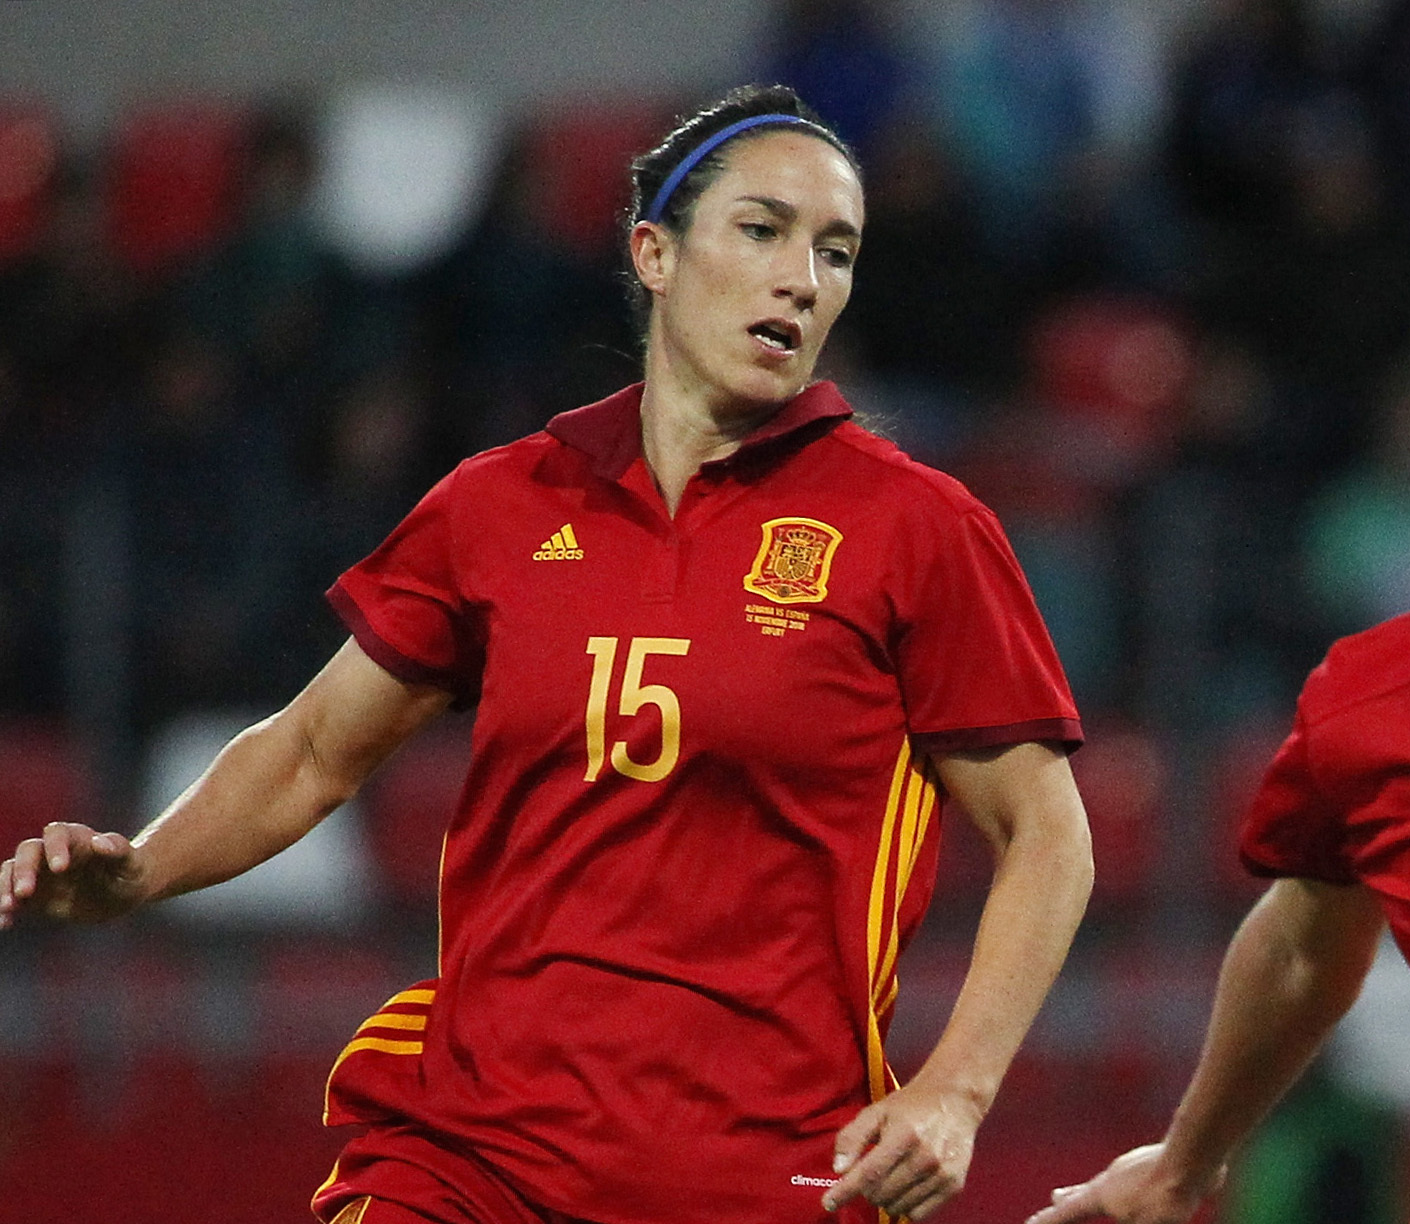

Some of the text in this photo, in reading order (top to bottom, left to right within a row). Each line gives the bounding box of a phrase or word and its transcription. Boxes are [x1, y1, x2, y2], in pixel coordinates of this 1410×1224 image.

[532, 548, 584, 561] adidas
[584, 637, 691, 782] 15
[790, 1174, 841, 1187] climaco
